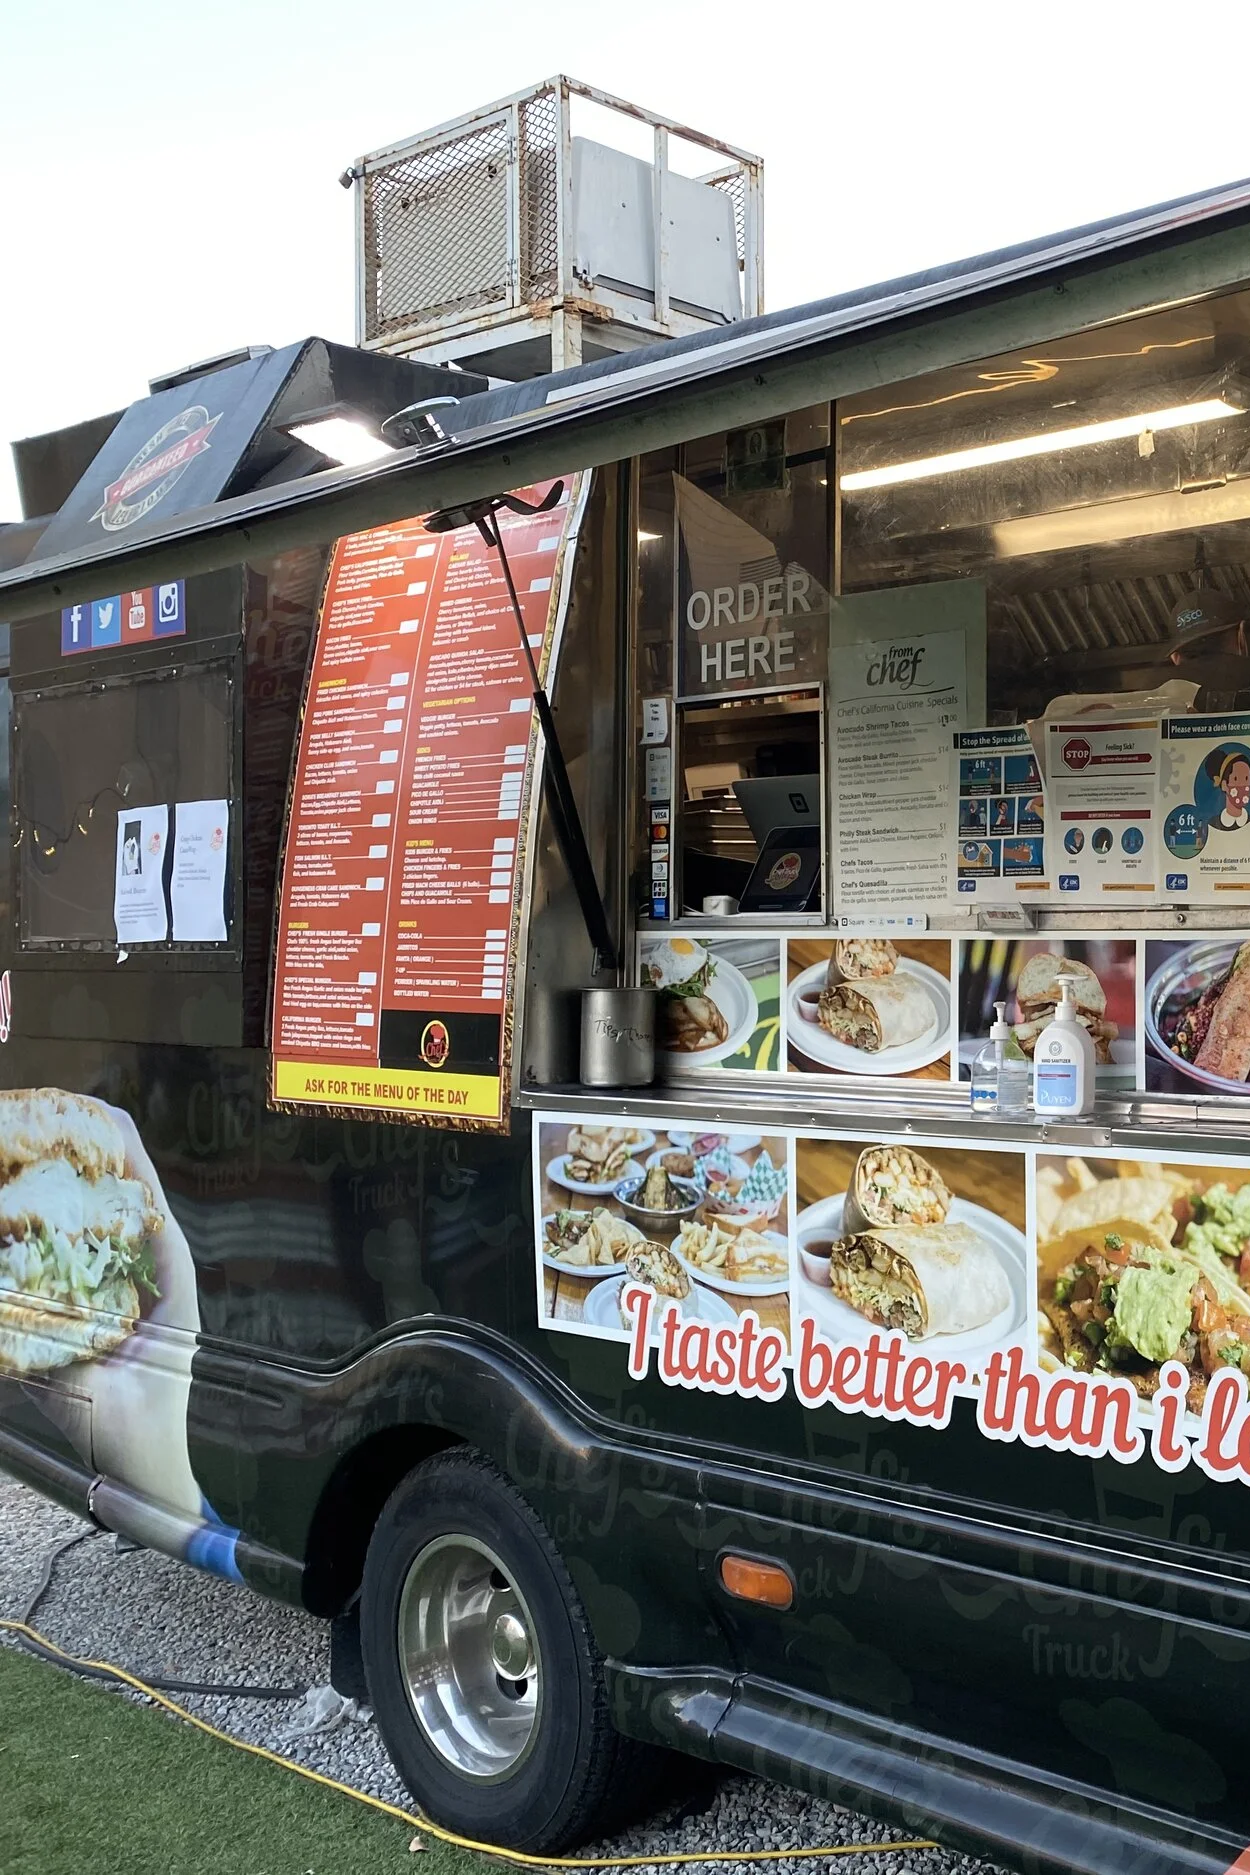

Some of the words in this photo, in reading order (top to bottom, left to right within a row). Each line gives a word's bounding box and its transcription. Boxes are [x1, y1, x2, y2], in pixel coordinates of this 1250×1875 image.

[131, 590, 143, 606] You
[686, 573, 812, 630] ORDER
[130, 610, 144, 625] Tube
[701, 631, 795, 683] HERE
[888, 645, 914, 661] from
[866, 648, 927, 690] chef
[837, 706, 860, 718] Chef's
[860, 703, 895, 715] California
[896, 700, 924, 711] Cuisine
[927, 695, 958, 709] Specials
[836, 725, 864, 735] Avocado
[865, 722, 889, 732] Shrimp
[890, 720, 910, 729] Tacos
[1171, 725, 1191, 734] Please
[1192, 725, 1207, 733] wear
[1213, 723, 1227, 732] cloth
[1228, 722, 1240, 731] face
[962, 737, 979, 746] Stop
[979, 736, 991, 745] the
[991, 734, 1016, 745] Spread
[1105, 743, 1123, 752] Feeling
[837, 755, 861, 764] Avocado
[862, 753, 878, 762] Steak
[879, 752, 899, 760] Burrito
[1065, 750, 1089, 759] STOP
[975, 760, 980, 769] 6
[979, 760, 986, 768] ft
[838, 792, 860, 801] Chicken
[861, 791, 877, 800] Wrap
[653, 811, 667, 819] VISA
[1178, 814, 1185, 826] 6
[1186, 813, 1195, 826] ft
[839, 829, 855, 838] Philly
[855, 828, 871, 836] Steak
[872, 827, 899, 835] Sandwich
[858, 880, 888, 888] Quesadilla
[305, 1078, 325, 1093] ASK
[328, 1080, 348, 1095] FOR
[350, 1082, 371, 1097] THE
[374, 1083, 403, 1100] MENU
[406, 1086, 420, 1101] OF
[423, 1088, 444, 1103] THE
[447, 1090, 469, 1105] DAY
[660, 1307, 784, 1394] taste
[798, 1319, 970, 1419] better
[981, 1348, 1141, 1455] than
[1155, 1369, 1198, 1466] i
